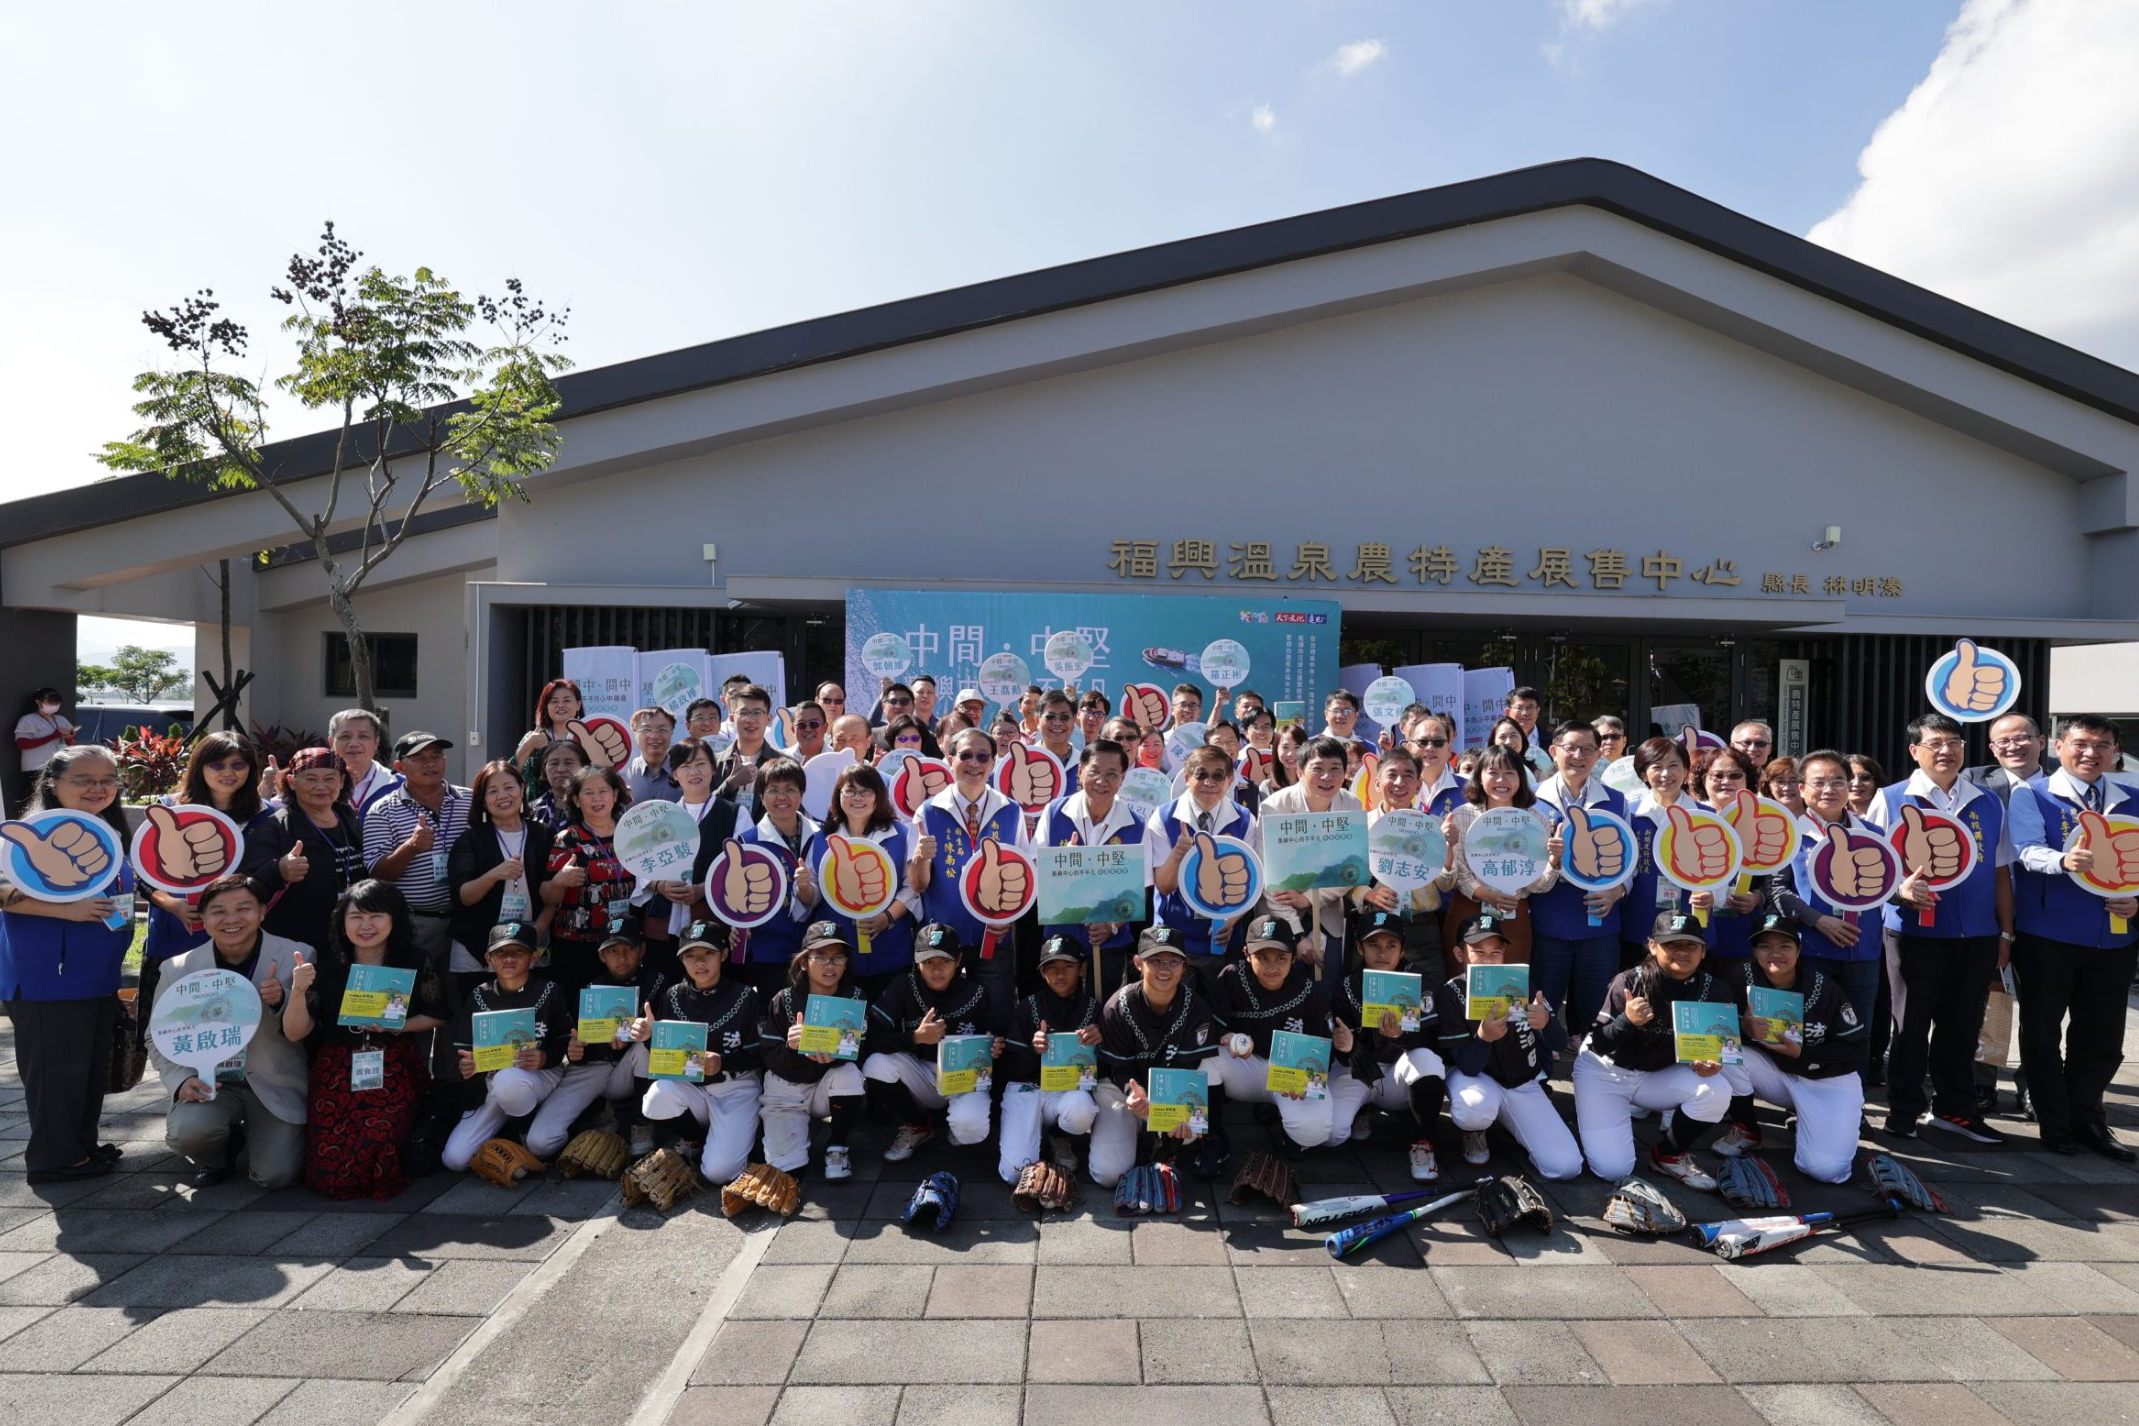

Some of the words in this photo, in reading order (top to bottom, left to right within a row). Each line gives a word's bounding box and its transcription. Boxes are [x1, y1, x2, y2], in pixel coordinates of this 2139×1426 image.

[1107, 538, 1742, 591] 福興溫泉農特產展售中心
[1761, 573, 1811, 595] 縣長
[1371, 705, 1404, 718] 張文
[1279, 816, 1350, 836] 中間·中堅
[639, 841, 694, 874] 李亞駿
[1054, 850, 1126, 869] 中間·中堅
[1482, 859, 1537, 877] 高郁淳
[1377, 857, 1430, 881] 劉志安
[176, 975, 237, 997] 中間·中堅
